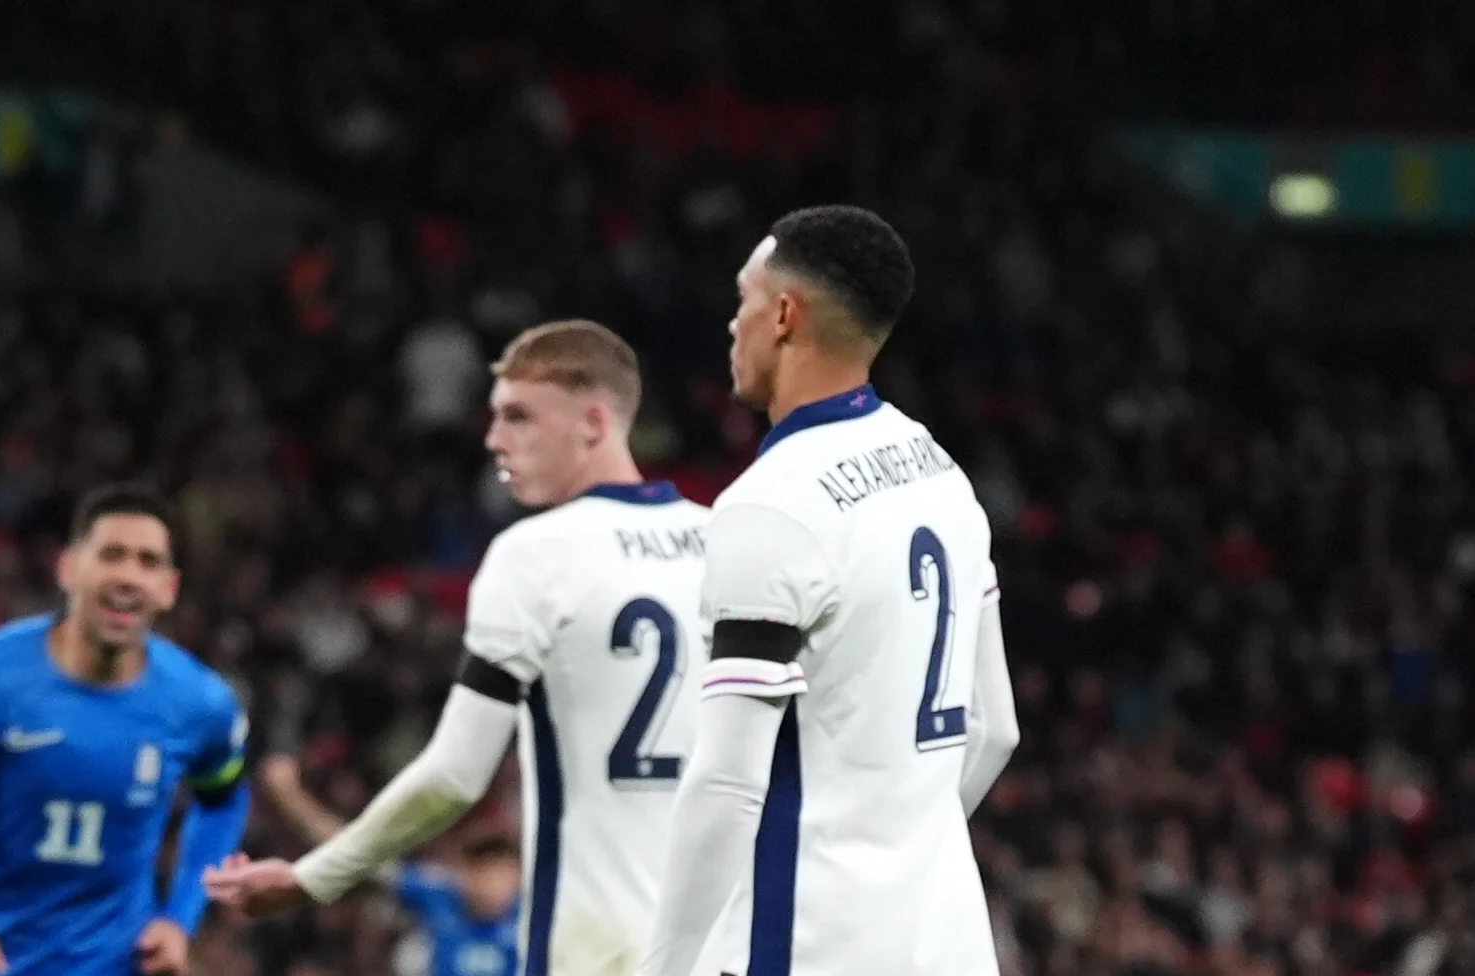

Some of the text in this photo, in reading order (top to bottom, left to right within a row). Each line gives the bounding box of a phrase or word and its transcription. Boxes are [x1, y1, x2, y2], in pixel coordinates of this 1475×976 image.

[609, 597, 689, 790] 2
[910, 526, 968, 752] 2
[33, 800, 105, 865] 11
